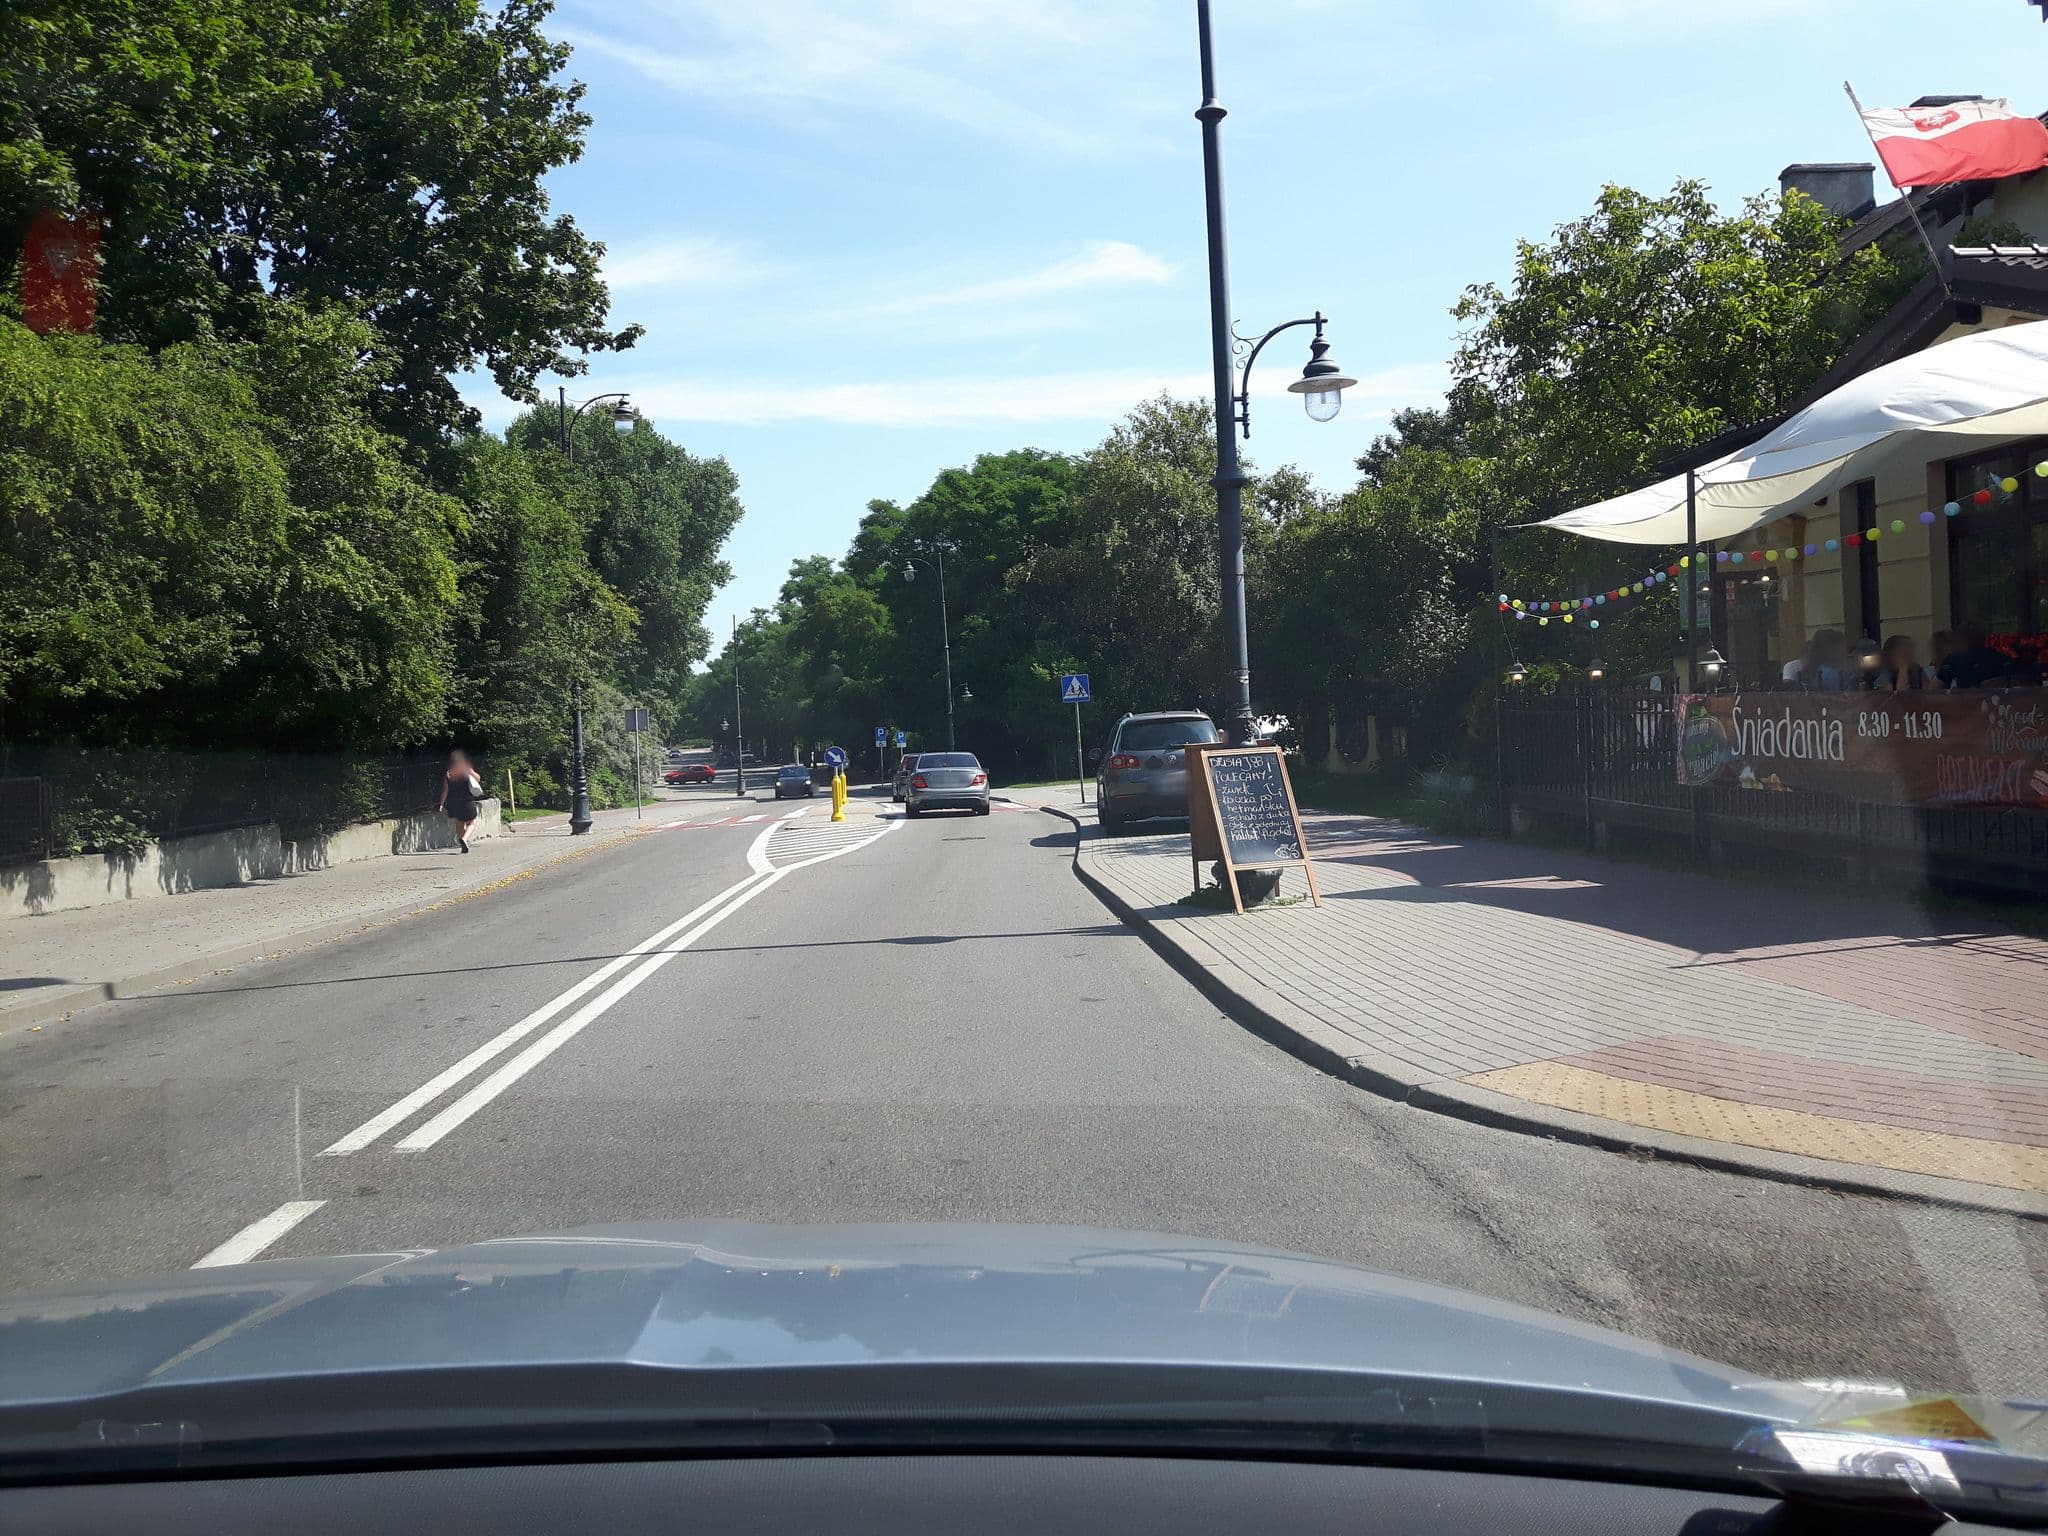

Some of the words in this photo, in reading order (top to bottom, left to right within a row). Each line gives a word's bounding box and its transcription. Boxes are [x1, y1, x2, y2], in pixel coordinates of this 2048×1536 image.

[878, 728, 885, 737] P
[898, 732, 905, 740] P
[1731, 695, 1844, 761] Śniadania
[1857, 711, 1889, 738] 8.30
[1903, 711, 1942, 739] 11.30
[1936, 752, 2026, 804] BREAKFAST
